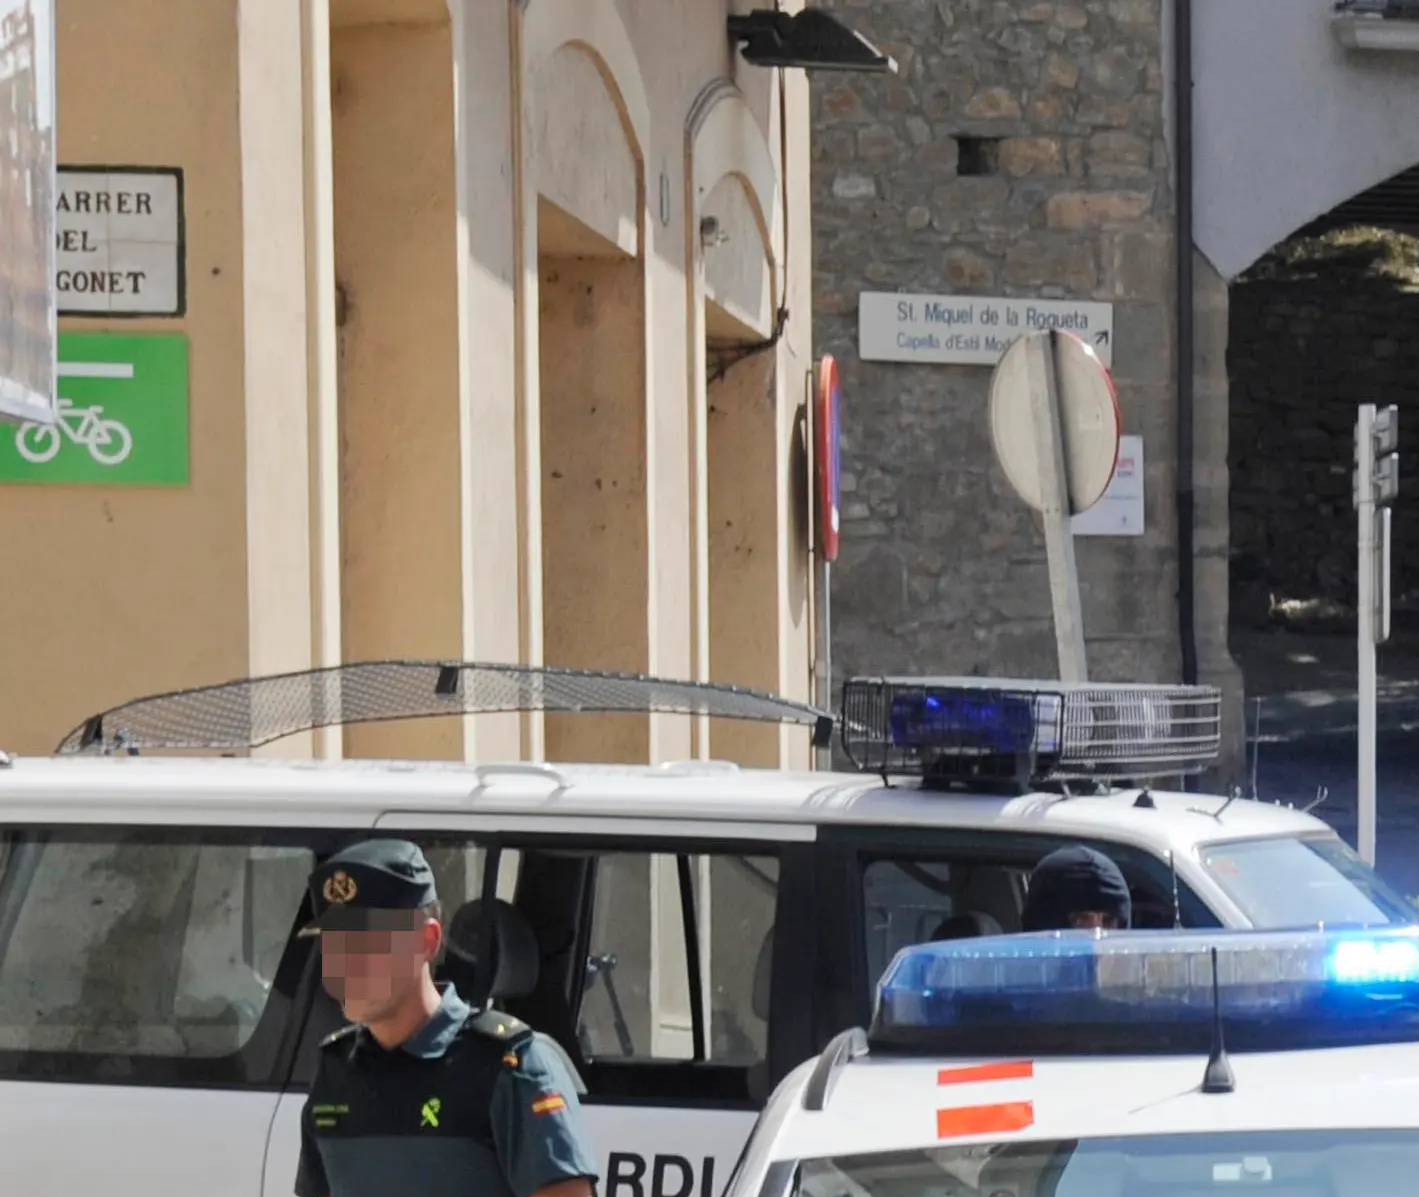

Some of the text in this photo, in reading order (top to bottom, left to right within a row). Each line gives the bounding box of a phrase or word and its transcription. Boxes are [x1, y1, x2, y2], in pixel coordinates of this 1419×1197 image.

[56, 191, 153, 214] ARRER
[56, 270, 146, 294] GONET
[925, 304, 974, 328] Miquel
[980, 306, 999, 326] de
[1006, 307, 1020, 327] la
[1026, 307, 1089, 331] Roqueta
